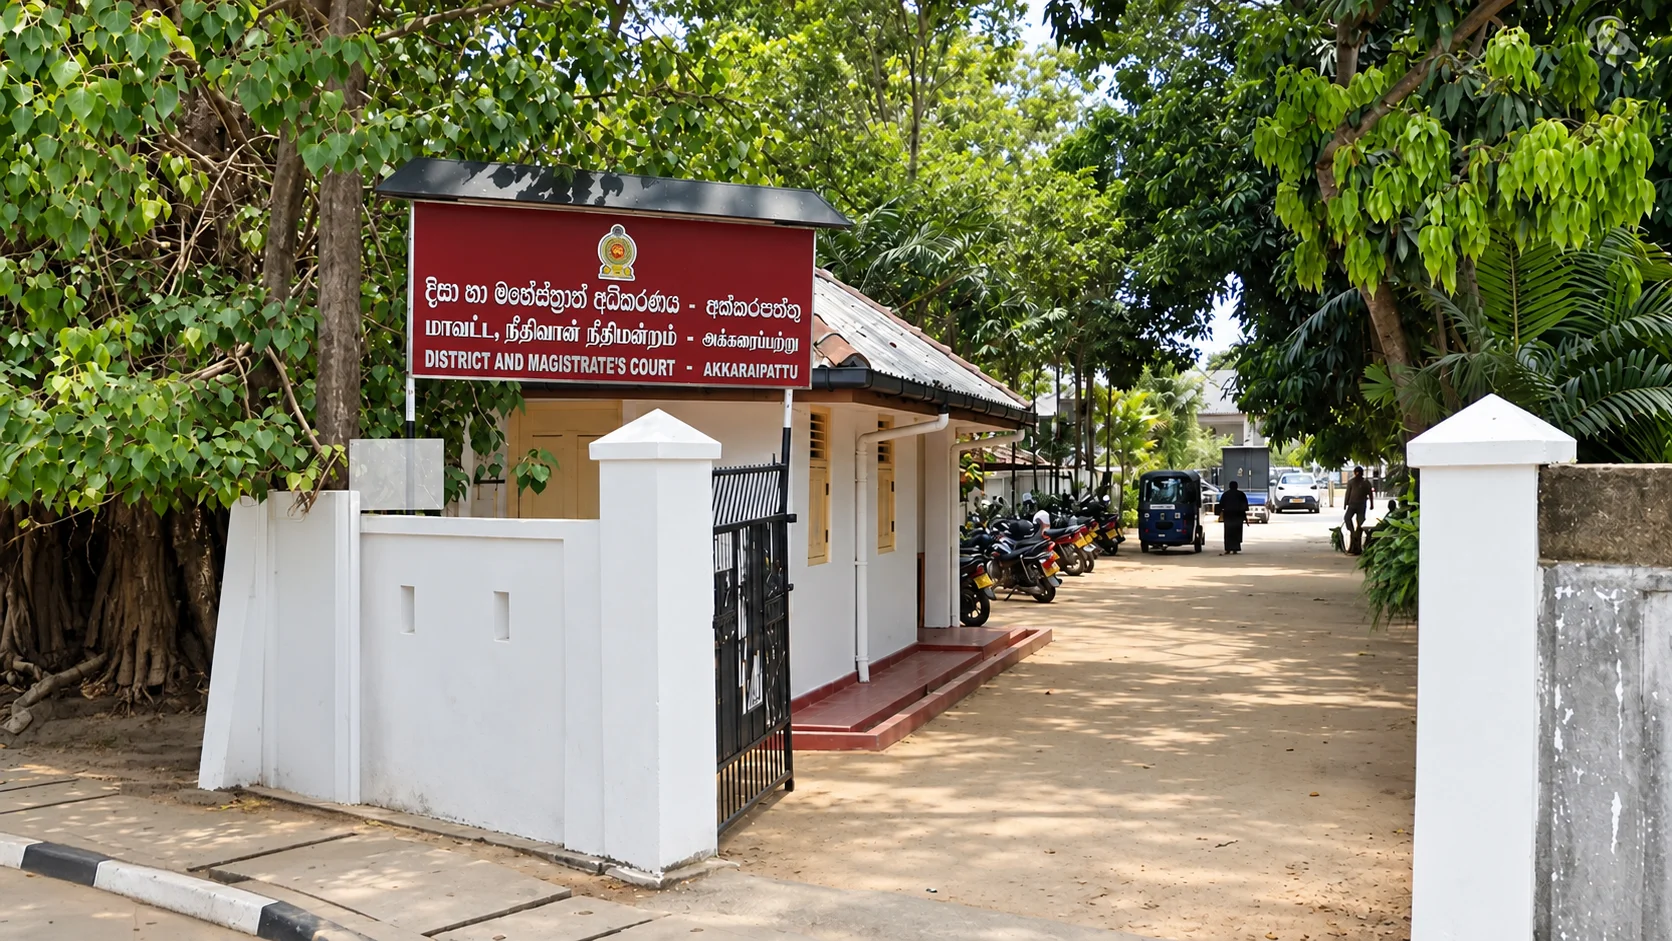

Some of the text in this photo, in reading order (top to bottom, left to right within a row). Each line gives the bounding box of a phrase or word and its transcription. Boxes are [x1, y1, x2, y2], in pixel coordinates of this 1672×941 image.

[424, 276, 460, 309] දිසා
[465, 284, 488, 304] හා
[593, 283, 680, 315] අධිකරණය
[705, 295, 802, 323] අක්කරපත්තු
[424, 314, 500, 342] மாவட்ட,
[503, 315, 581, 345] நீதிவான்
[586, 319, 677, 350] நீதிமன்றம்
[701, 328, 799, 355] அக்கரைப்பற்று
[424, 350, 491, 371] DISTRICT
[493, 353, 524, 372] AND
[527, 354, 627, 376] MAGISTRATE'S
[629, 358, 677, 377] COURT
[703, 362, 799, 380] AKKARAIPATTU
